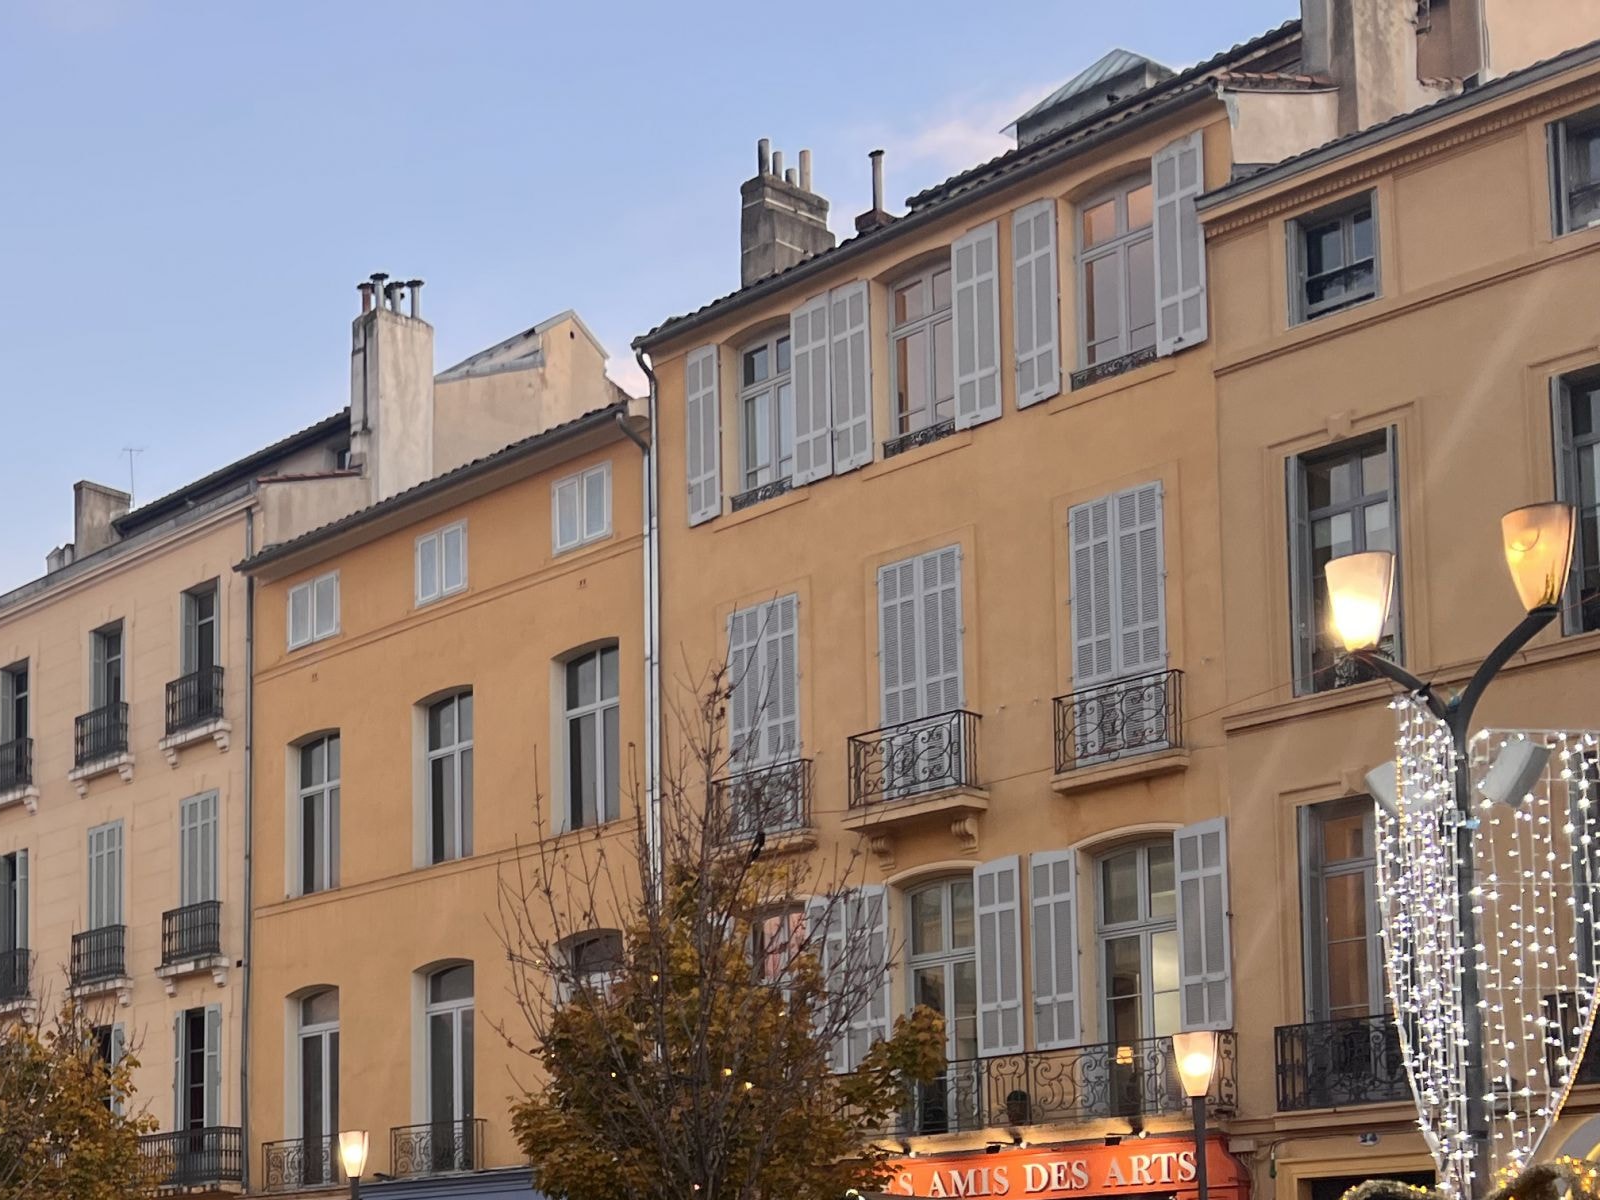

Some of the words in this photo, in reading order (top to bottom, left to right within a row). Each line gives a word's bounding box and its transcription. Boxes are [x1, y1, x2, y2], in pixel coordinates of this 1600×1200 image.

[928, 1165, 1010, 1199] AMIS
[1023, 1160, 1090, 1194] DES
[1102, 1150, 1198, 1188] ARTS
